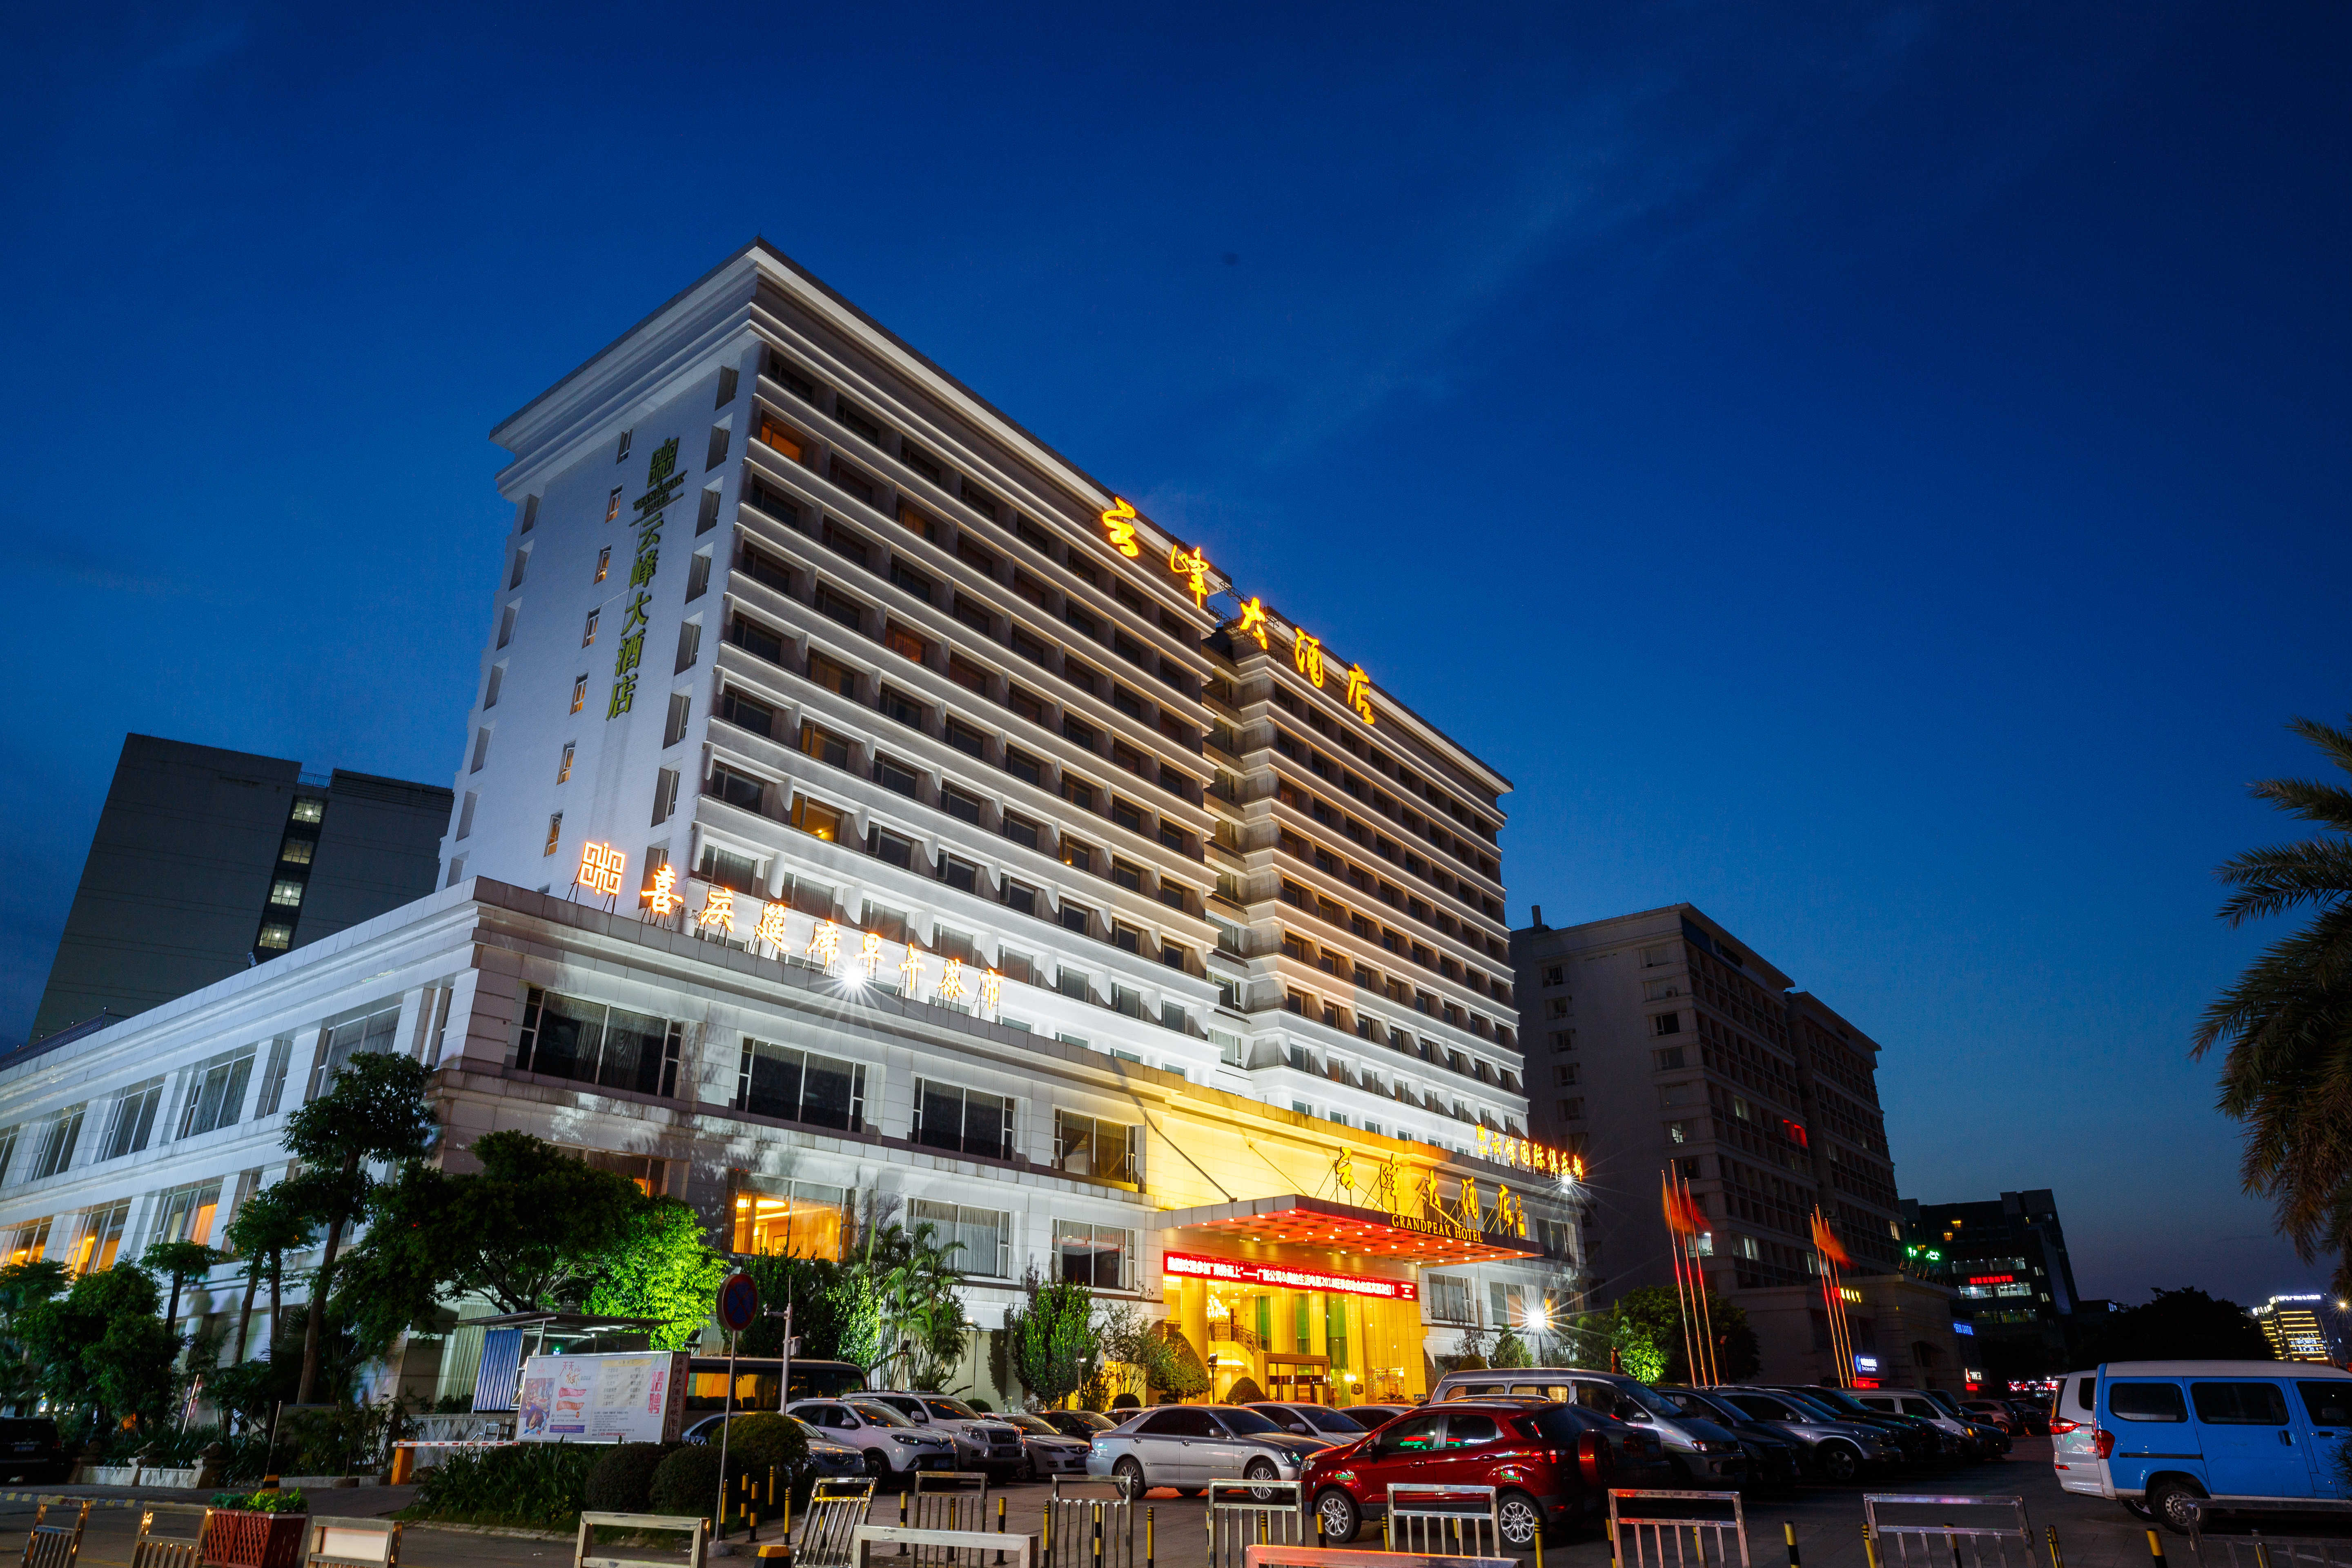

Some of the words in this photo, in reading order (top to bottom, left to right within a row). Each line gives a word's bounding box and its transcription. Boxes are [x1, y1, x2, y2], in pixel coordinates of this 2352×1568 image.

[633, 473, 684, 511] GRANDPEAK
[644, 491, 670, 514] HOTEL
[606, 512, 663, 721] 云峰大酒店
[1102, 497, 1375, 725] 云峰大酒店
[1335, 1146, 1513, 1227] 云峰大酒店
[1392, 1214, 1452, 1237] GRANDPEAK
[1454, 1226, 1483, 1243] HOTEL
[648, 1371, 664, 1414] 招聘
